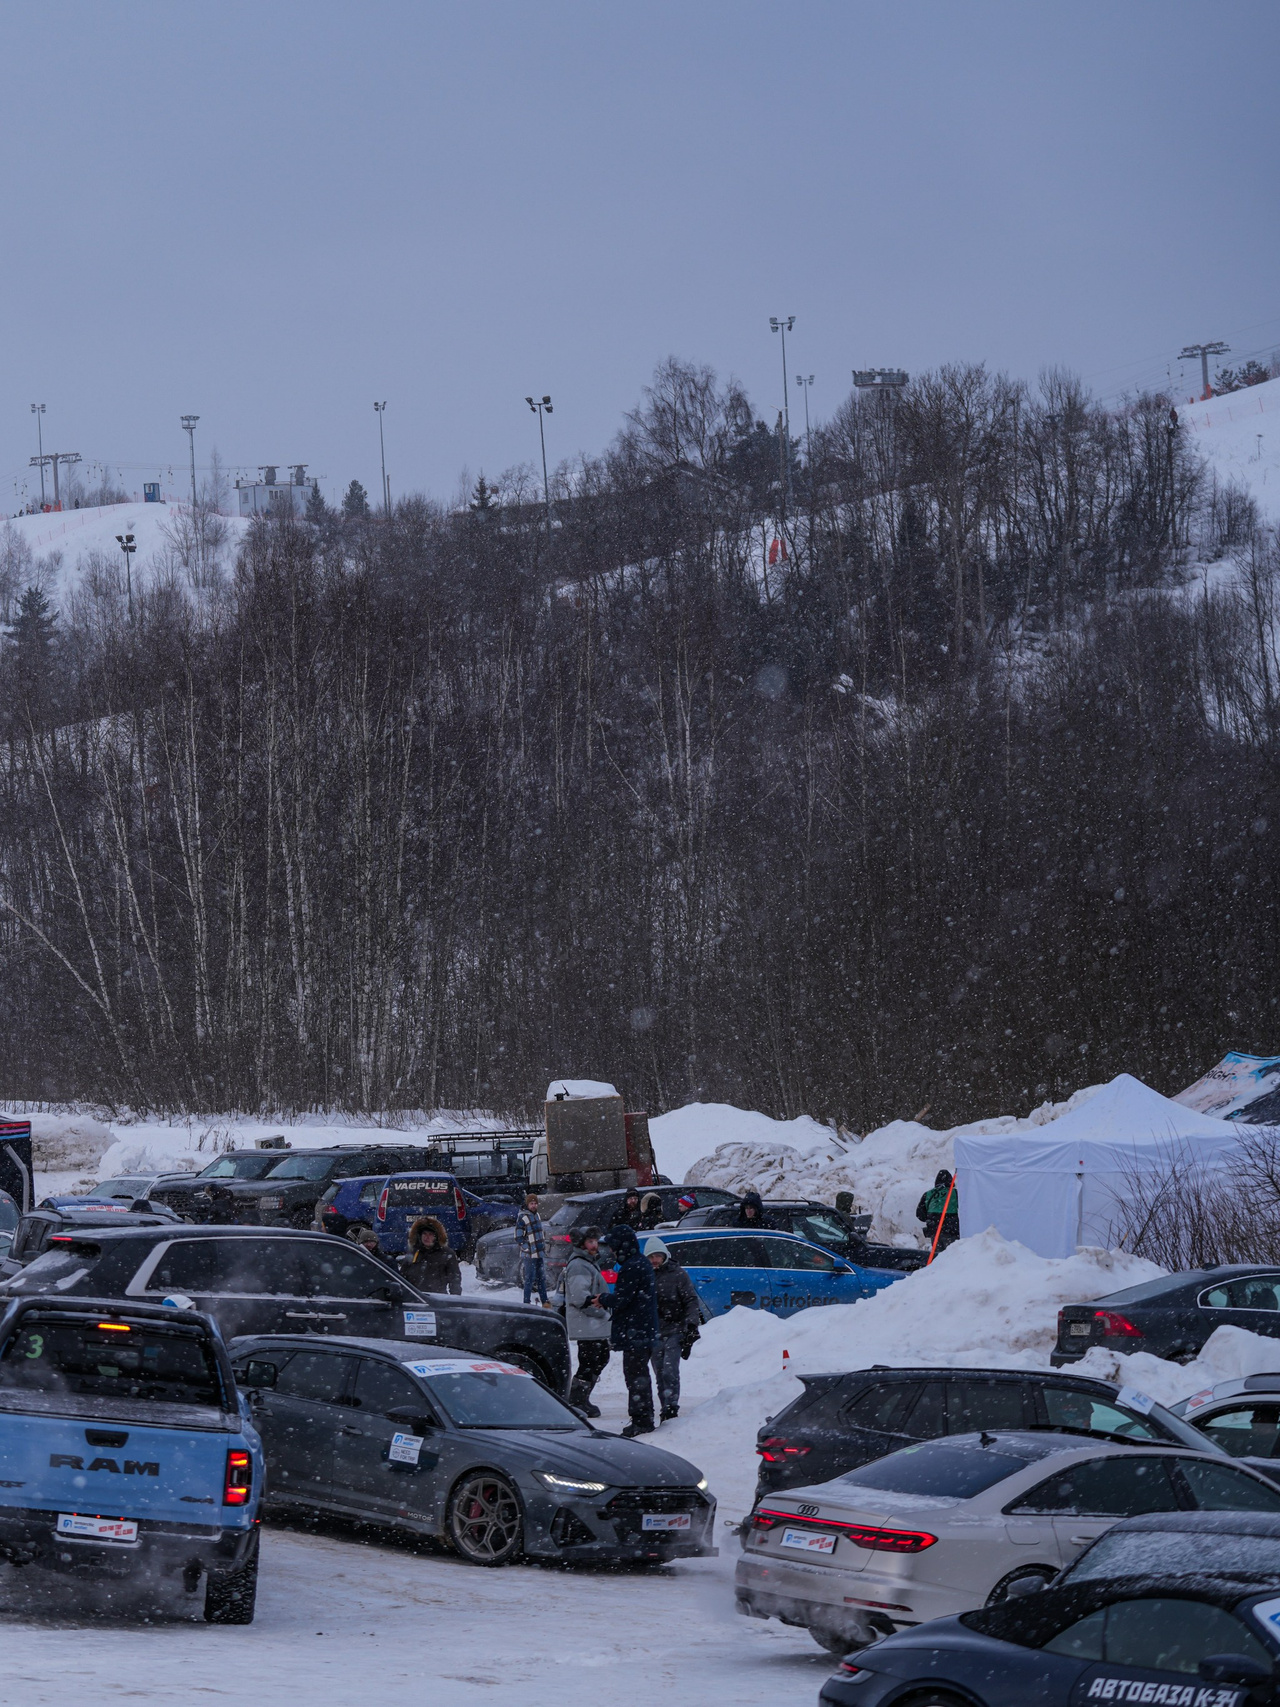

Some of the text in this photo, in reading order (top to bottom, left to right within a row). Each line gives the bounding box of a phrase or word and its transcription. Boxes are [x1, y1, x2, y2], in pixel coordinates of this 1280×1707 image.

[25, 1334, 44, 1359] 3
[49, 1454, 160, 1477] RAM
[1088, 1678, 1195, 1706] АВТОБАЗА
